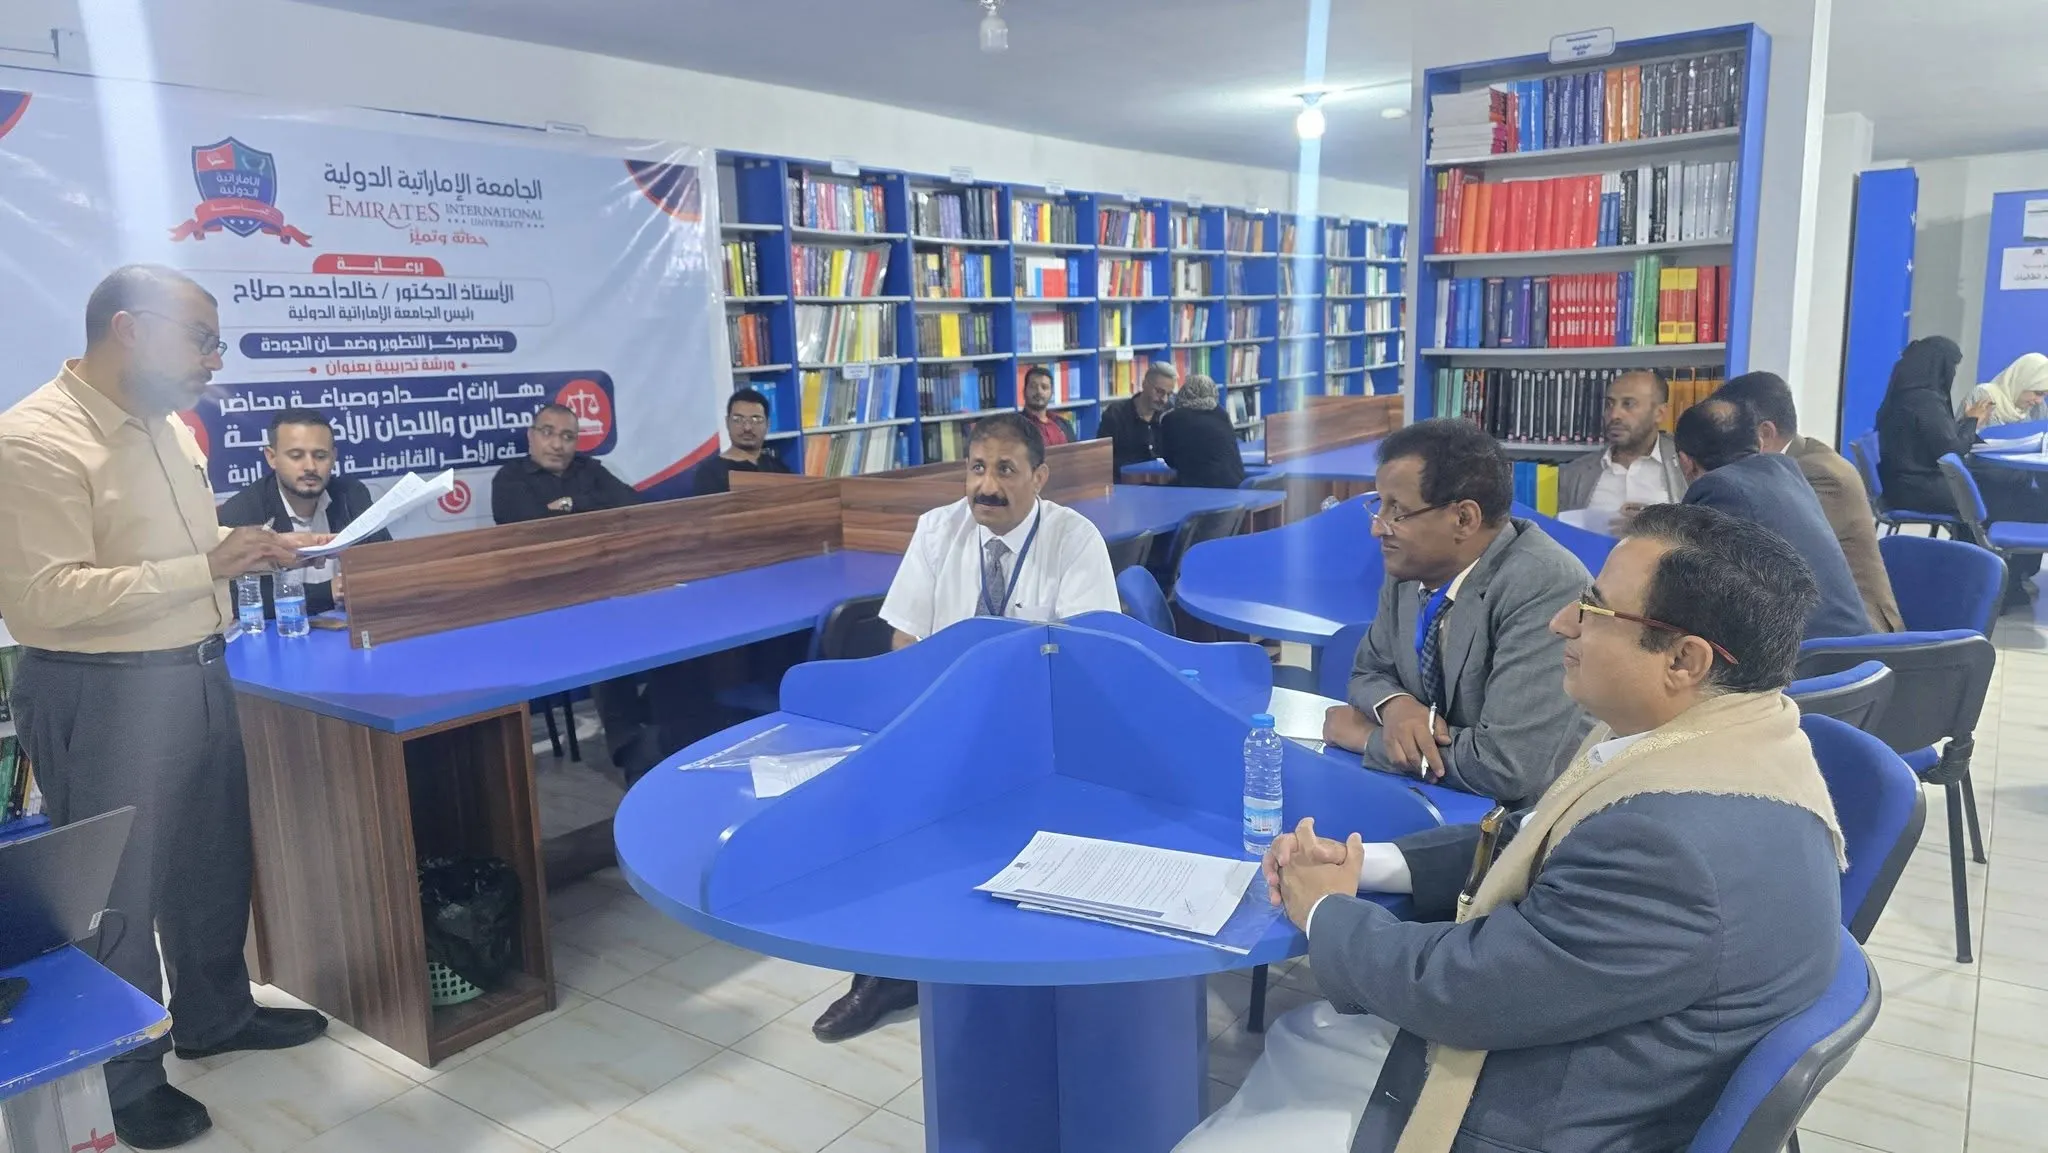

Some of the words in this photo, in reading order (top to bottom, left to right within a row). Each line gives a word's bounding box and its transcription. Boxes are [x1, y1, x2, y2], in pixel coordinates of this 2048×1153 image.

[324, 162, 392, 192] الدولية
[398, 169, 471, 201] الإماراتية
[476, 177, 543, 203] الجامعة
[327, 194, 440, 230] EMIRATES
[445, 203, 544, 220] INTERNATIONAL
[470, 218, 524, 228] UNIVERSITY
[452, 229, 489, 247] حداثة
[337, 256, 424, 275] برعاية
[233, 278, 285, 303] صلاح
[396, 283, 457, 302] الدكتور
[461, 280, 514, 304] الأستاذ
[288, 304, 336, 321] الدولية
[338, 304, 391, 324] الإماراتية
[394, 306, 441, 321] الجامعة
[443, 306, 474, 322] رئيس
[261, 335, 312, 353] الجودة
[314, 335, 378, 353] وضمان
[380, 334, 427, 352] التطوير
[428, 334, 472, 350] مركز
[473, 333, 504, 350] ينظم
[325, 360, 372, 376] بعنوان
[375, 358, 419, 376] تدريبية
[422, 355, 455, 372] ورشة
[290, 385, 380, 411] وصياغة
[382, 382, 464, 405] إعداد
[467, 380, 545, 402] مهارات
[219, 391, 286, 417] محاضر
[374, 410, 455, 442] واللجان
[345, 447, 435, 476] القانونية
[440, 440, 494, 467] الأطر
